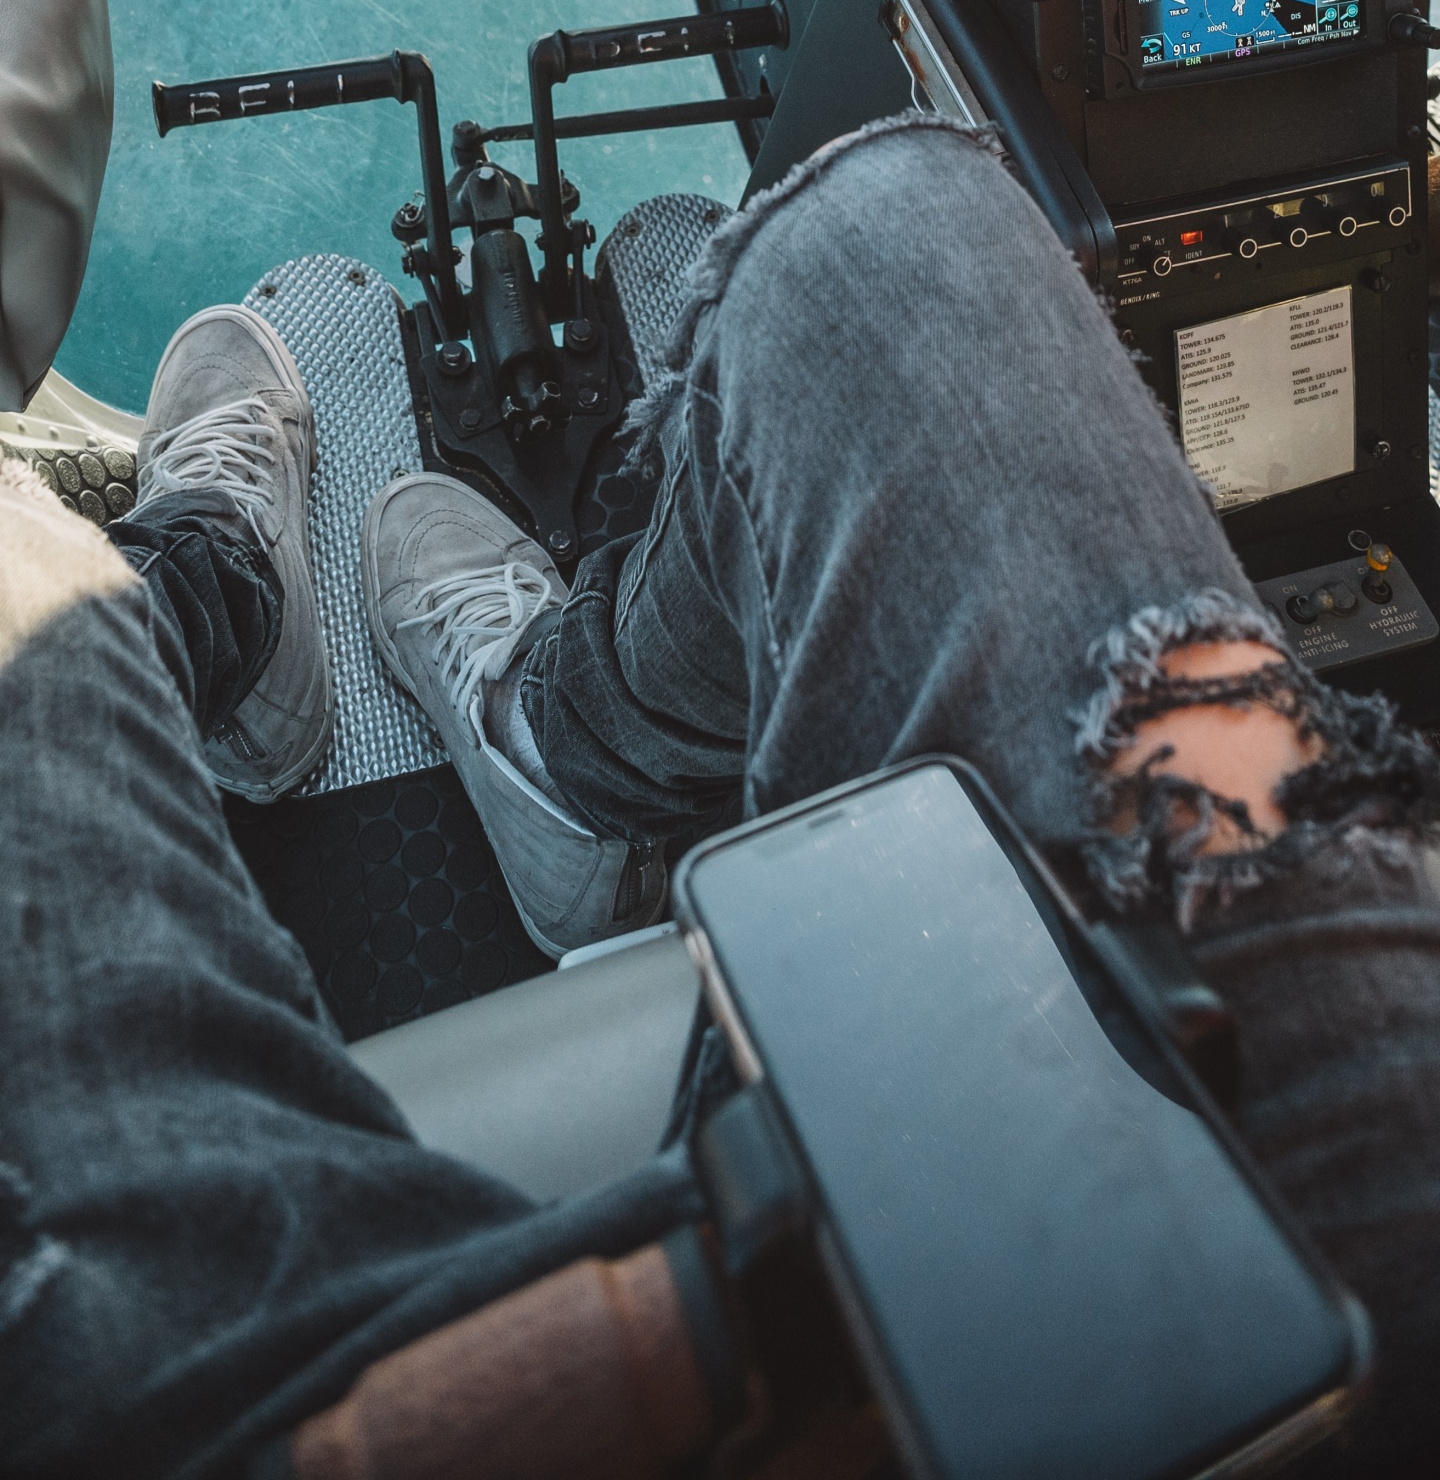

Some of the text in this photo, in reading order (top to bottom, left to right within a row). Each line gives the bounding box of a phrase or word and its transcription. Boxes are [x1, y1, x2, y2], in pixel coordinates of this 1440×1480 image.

[1304, 23, 1316, 33] NM
[1343, 20, 1356, 28] Out
[1173, 44, 1201, 56] 91 KT
[1235, 48, 1251, 58] GPS
[1144, 55, 1162, 64] Back
[1185, 57, 1201, 66] ENR
[1155, 238, 1165, 246] ALT
[1185, 251, 1202, 260] IDENT
[1120, 291, 1160, 305] BENDIX/KING
[1290, 312, 1311, 321] TOWER:
[1290, 319, 1320, 331] ATIS: 135.0
[1179, 332, 1194, 340] KOPF
[1290, 330, 1316, 341] GROUND:
[1180, 334, 1226, 350] TOWER: 134.675
[1291, 338, 1323, 350] CLEARANCE:
[1196, 348, 1211, 356] 125.9
[1181, 352, 1231, 370] GROUND: 120.025
[1182, 367, 1215, 380] LANDMARK:
[1182, 379, 1210, 389] Company:
[1293, 376, 1314, 386] TOWER:
[1293, 387, 1307, 395] ATIS:
[1294, 389, 1338, 405] GROUND: 120.45
[1185, 407, 1207, 416] TOWER:
[1186, 425, 1212, 435] GROUND:
[1380, 606, 1398, 616] OFF
[1369, 611, 1420, 630] HYDRAULIC
[1304, 625, 1322, 636] OFF
[1383, 622, 1417, 637] SYSTEM
[1300, 632, 1337, 649] ENGINE
[1298, 640, 1349, 659] ANTI-ICING
